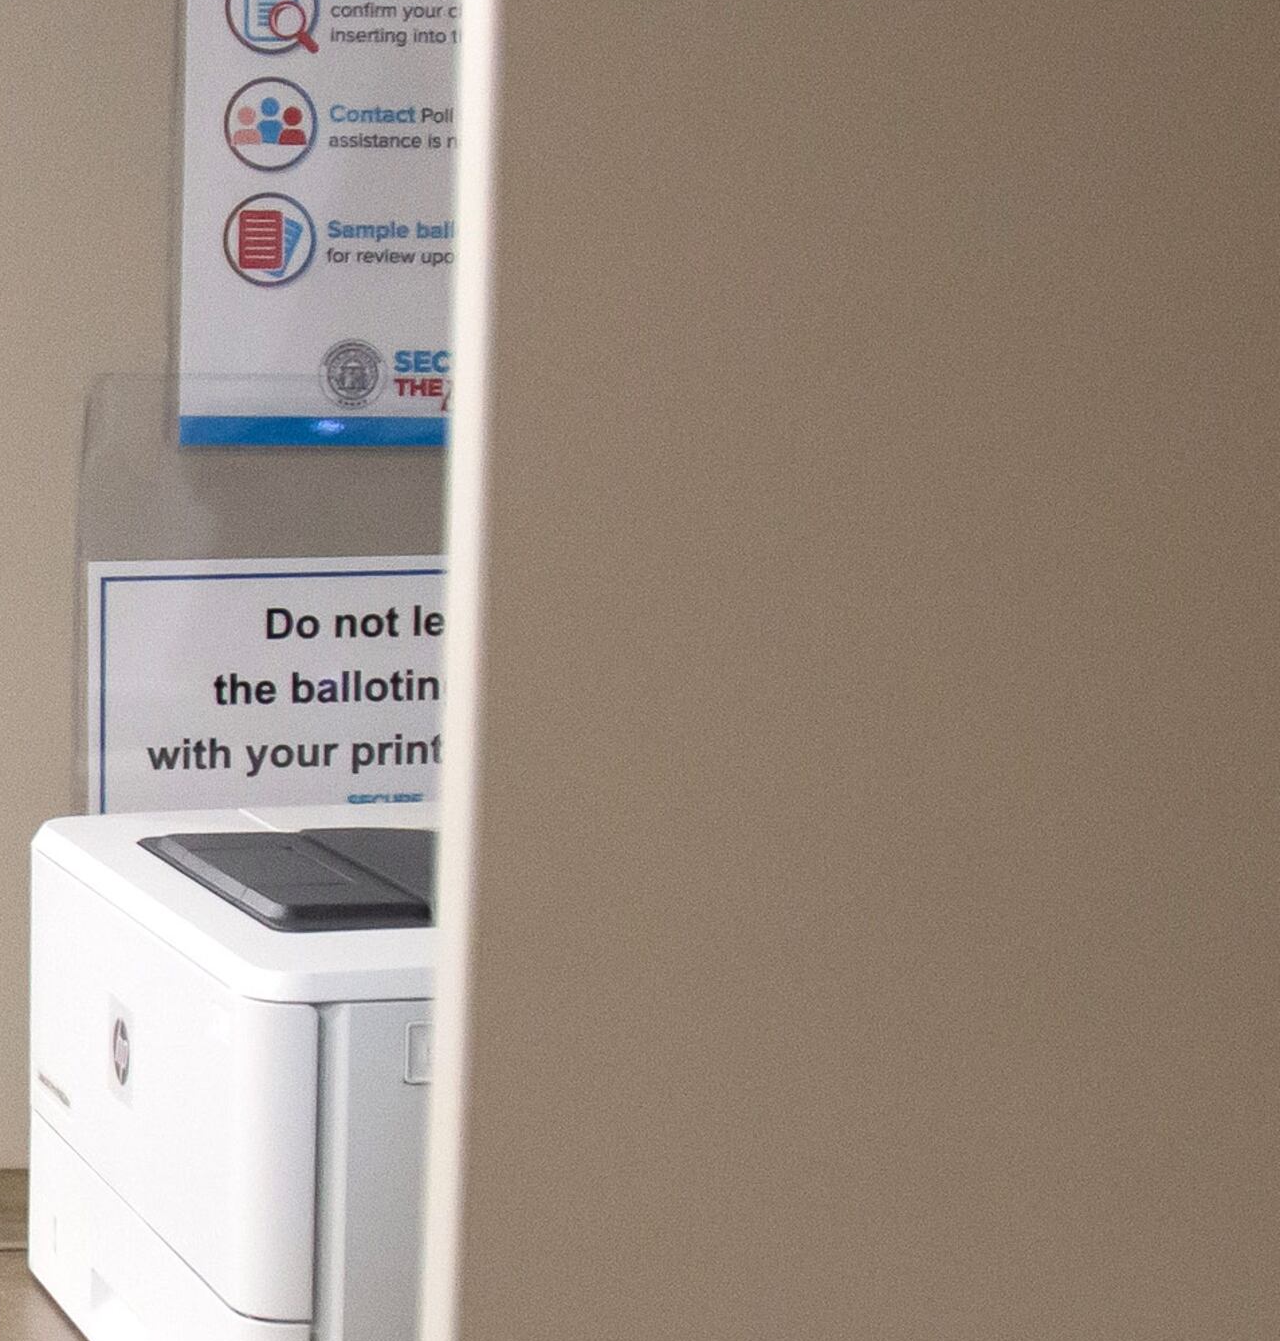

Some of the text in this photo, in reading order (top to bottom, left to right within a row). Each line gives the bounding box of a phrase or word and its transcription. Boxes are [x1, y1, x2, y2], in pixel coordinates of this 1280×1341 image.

[329, 2, 397, 19] confirm
[401, 6, 441, 22] your
[330, 27, 408, 47] inserting
[413, 28, 447, 43] into
[329, 104, 454, 124] Contact Poll
[328, 133, 423, 149] assistance
[427, 133, 442, 149] is
[327, 220, 410, 243] Sample
[326, 248, 352, 264] for
[356, 249, 416, 264] review
[393, 350, 449, 373] SEC
[393, 378, 443, 397] THE
[266, 607, 321, 640] Do
[334, 606, 400, 639] not
[214, 668, 441, 706] the ballotin
[146, 737, 232, 771] with
[244, 742, 339, 778] your
